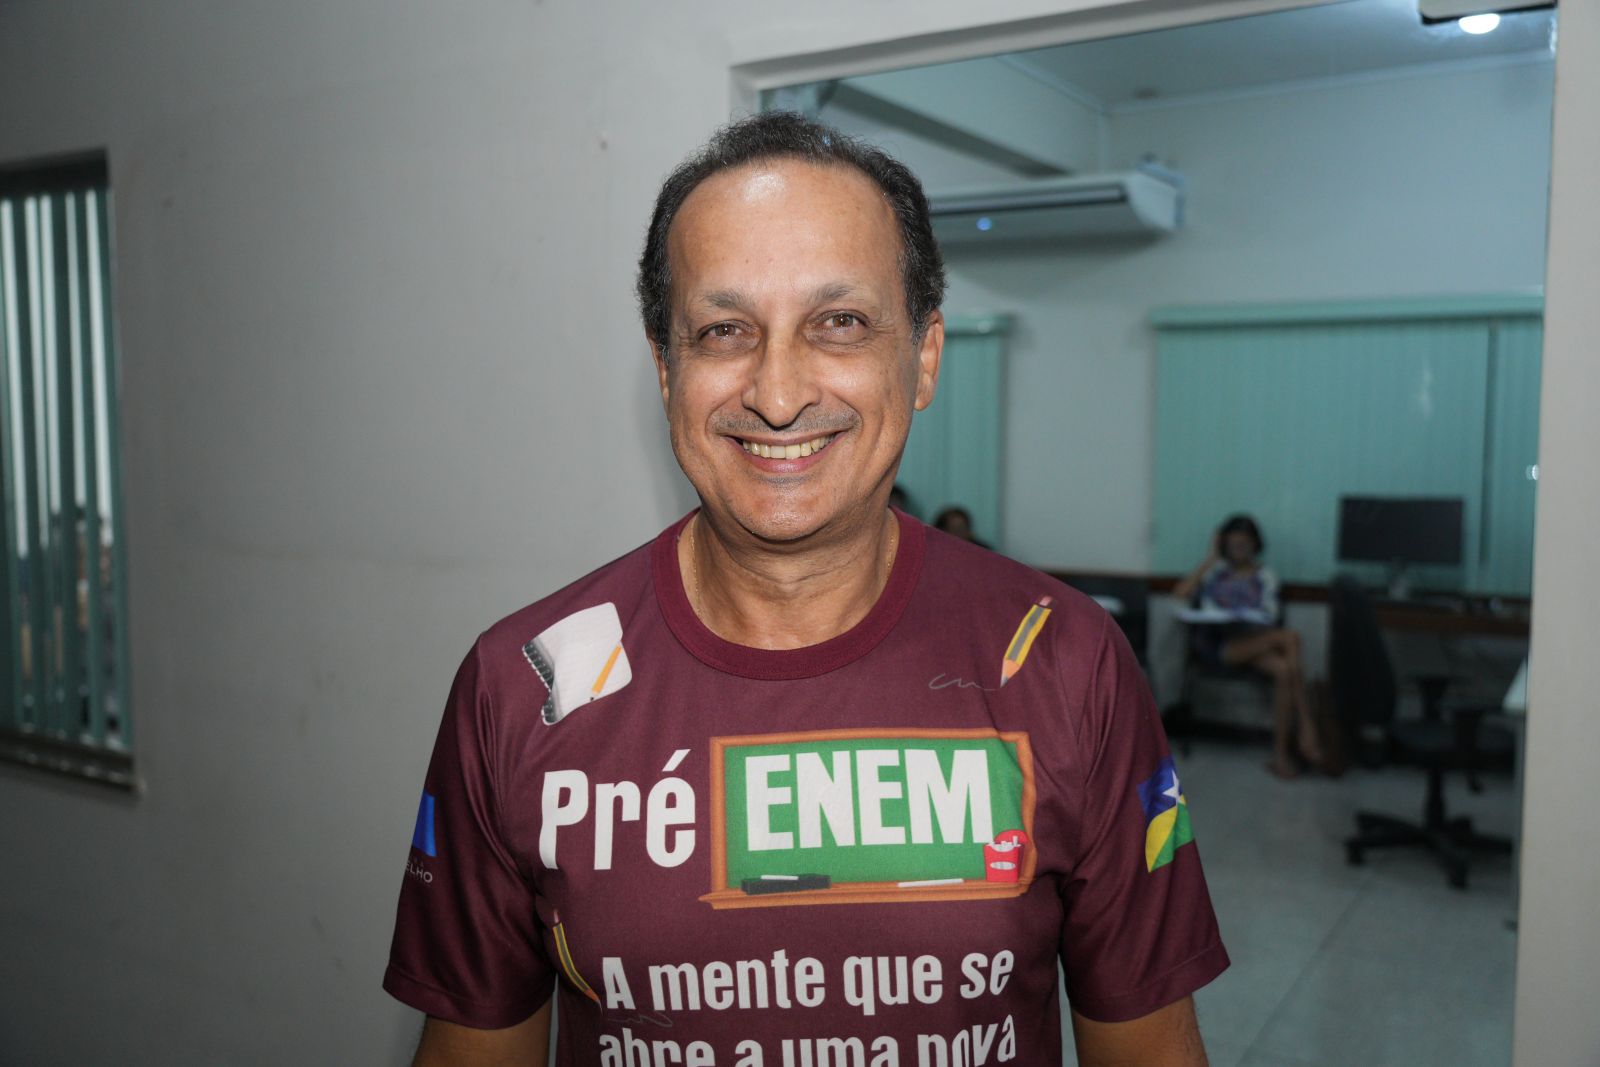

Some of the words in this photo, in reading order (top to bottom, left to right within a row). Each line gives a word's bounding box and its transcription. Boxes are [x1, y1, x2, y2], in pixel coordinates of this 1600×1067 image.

[538, 748, 697, 872] Pré
[744, 748, 993, 852] ENEM
[602, 956, 636, 1010] A
[648, 948, 827, 1011] mente
[842, 954, 944, 1016] que
[959, 949, 1015, 1000] se
[599, 1027, 716, 1067] abre
[734, 1039, 764, 1067] a
[781, 1035, 900, 1067] uma
[917, 1014, 1017, 1067] nova
